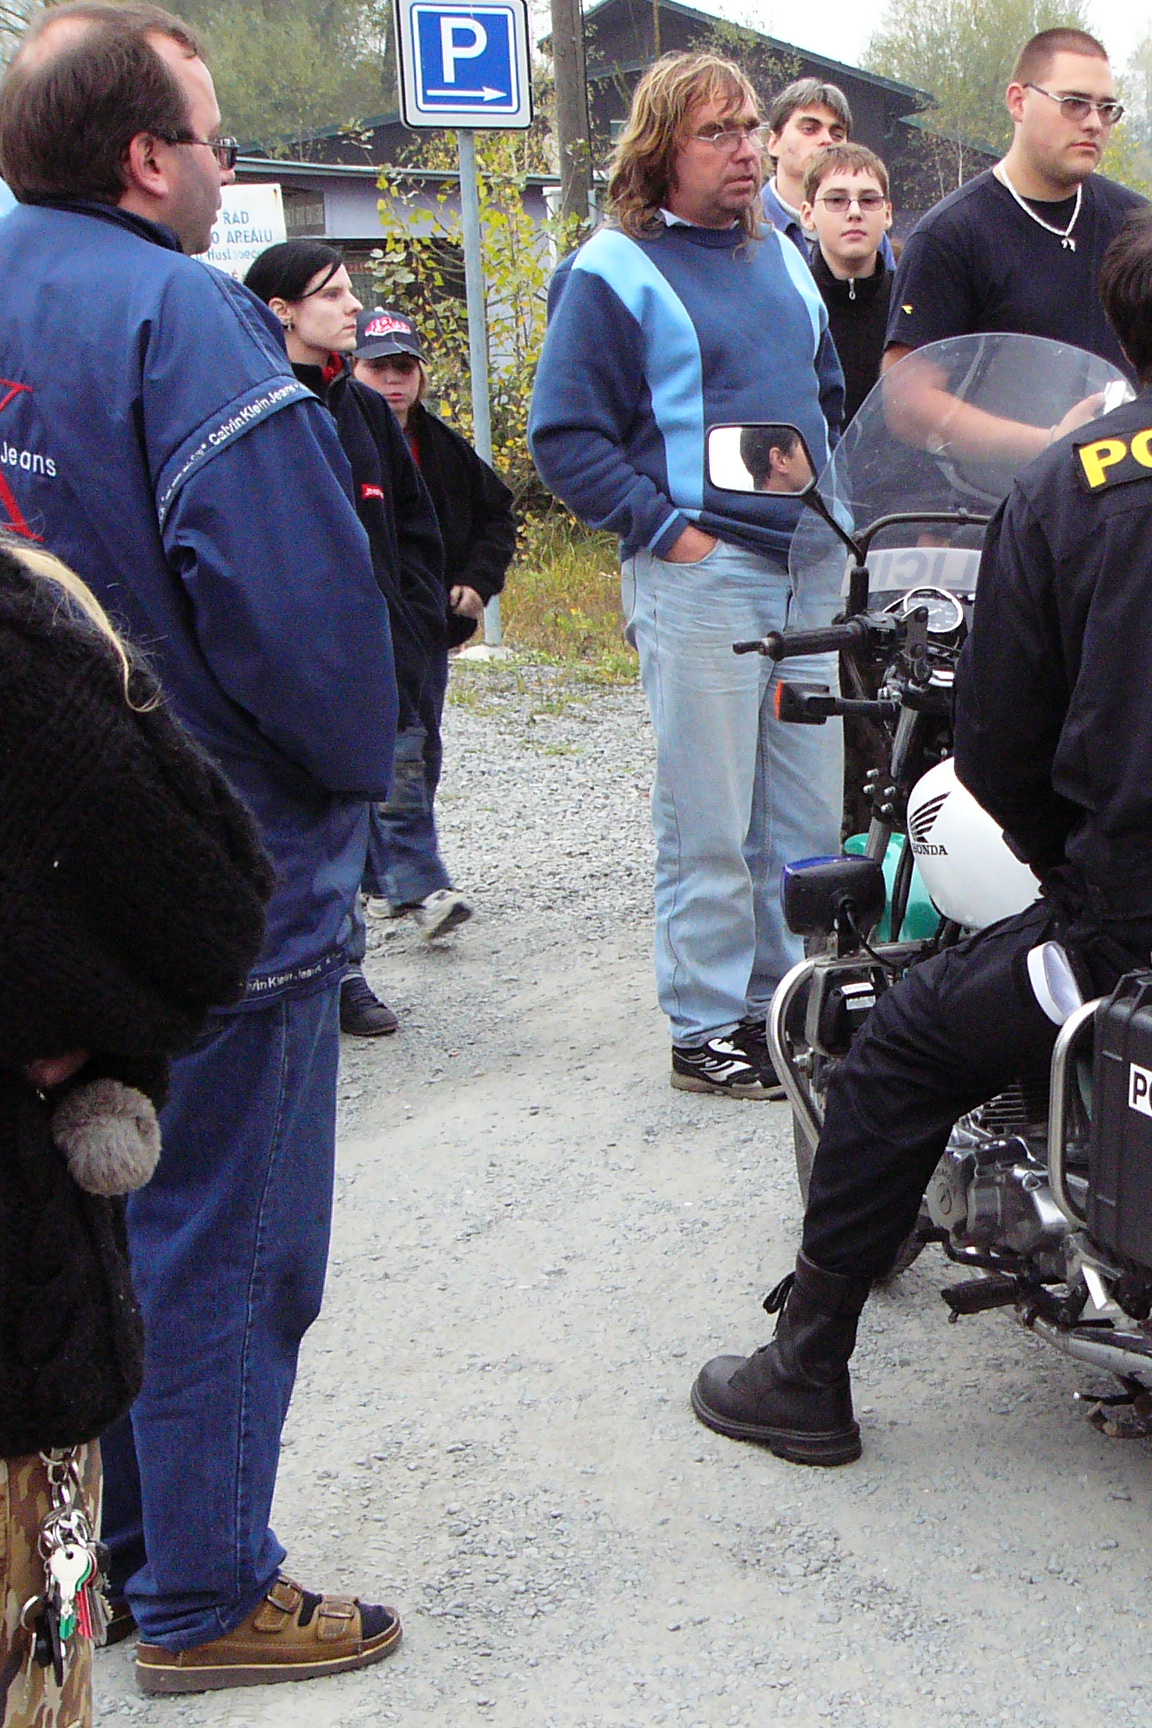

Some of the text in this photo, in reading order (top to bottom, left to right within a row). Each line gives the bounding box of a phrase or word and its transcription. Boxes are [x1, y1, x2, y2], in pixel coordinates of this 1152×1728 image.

[440, 16, 488, 83] P
[208, 416, 247, 445] Calvin
[240, 397, 271, 422] Klein
[0, 441, 57, 477] Jeans
[912, 843, 949, 856] HONDA
